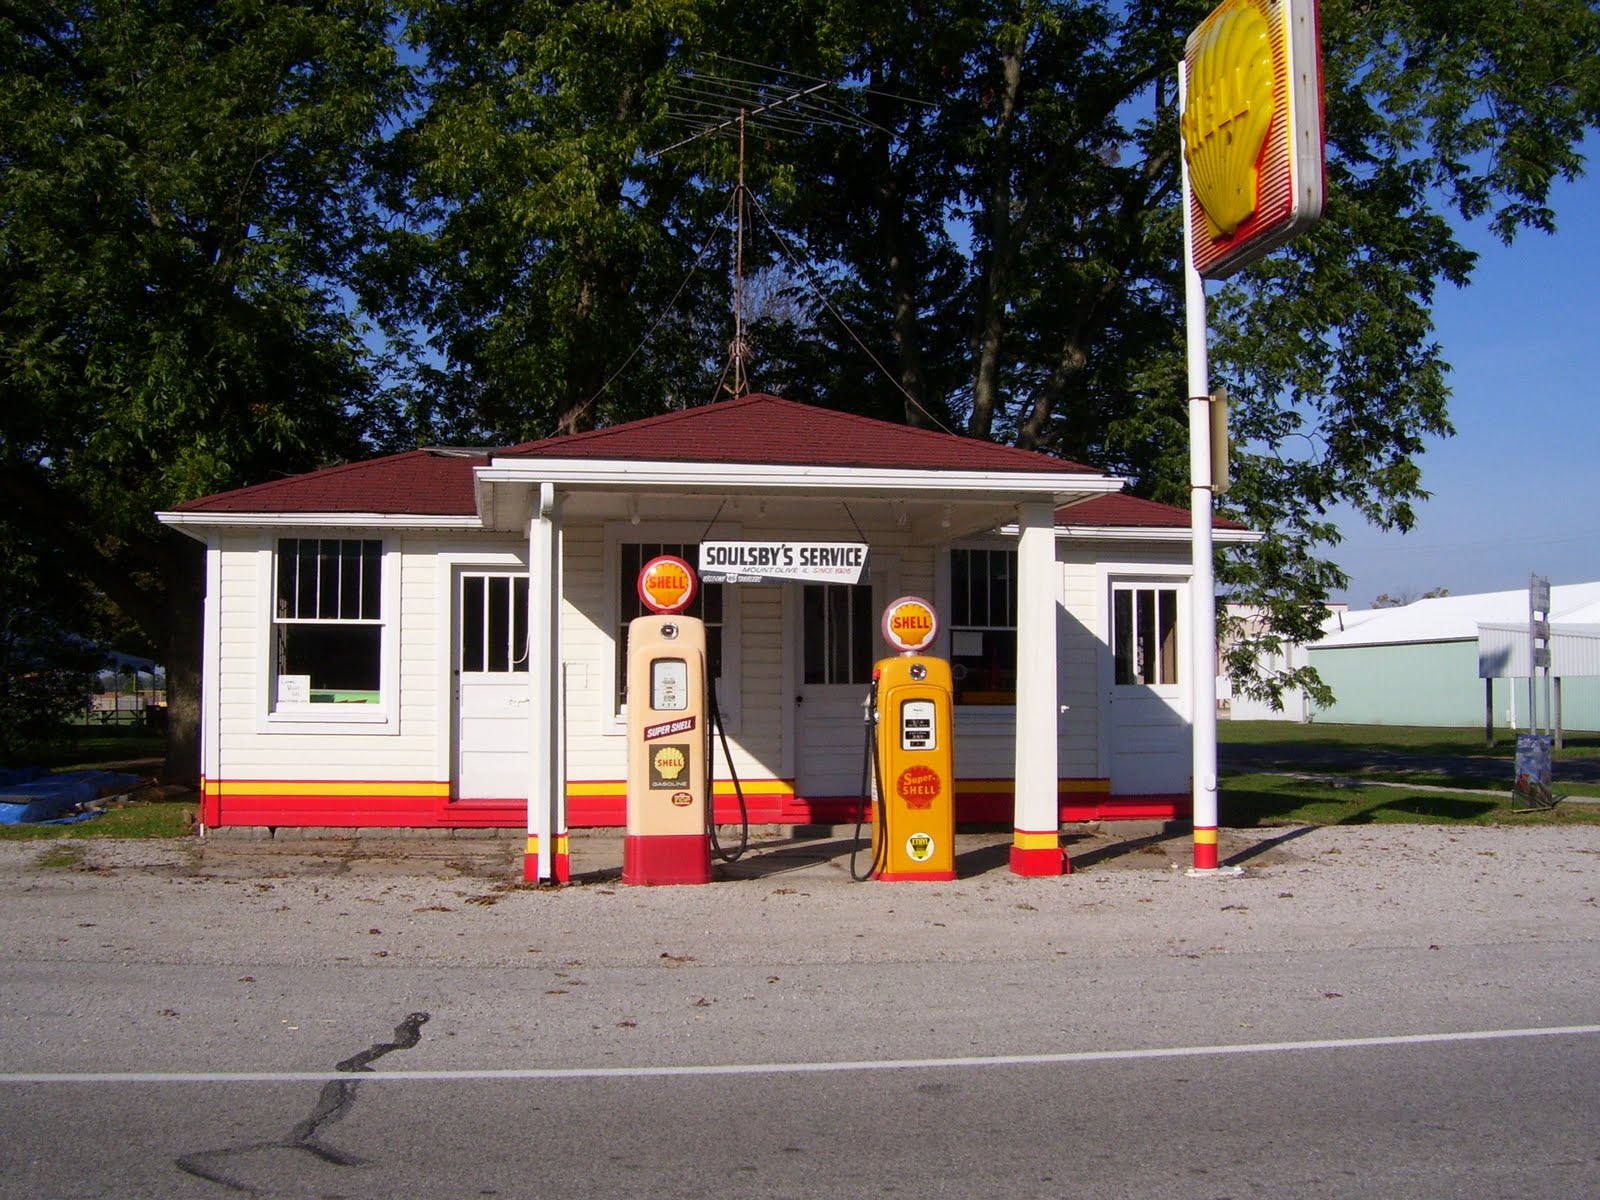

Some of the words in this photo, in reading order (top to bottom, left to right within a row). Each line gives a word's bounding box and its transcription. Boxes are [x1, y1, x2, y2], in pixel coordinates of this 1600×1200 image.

[706, 544, 793, 566] SOULSBY'S
[800, 547, 862, 566] SERVICE
[649, 576, 685, 589] SHELL
[894, 616, 929, 629] SHELL
[647, 725, 671, 738] SUPER
[671, 719, 692, 732] SHELL
[657, 759, 682, 767] SHELL
[903, 786, 936, 795] SHELL
